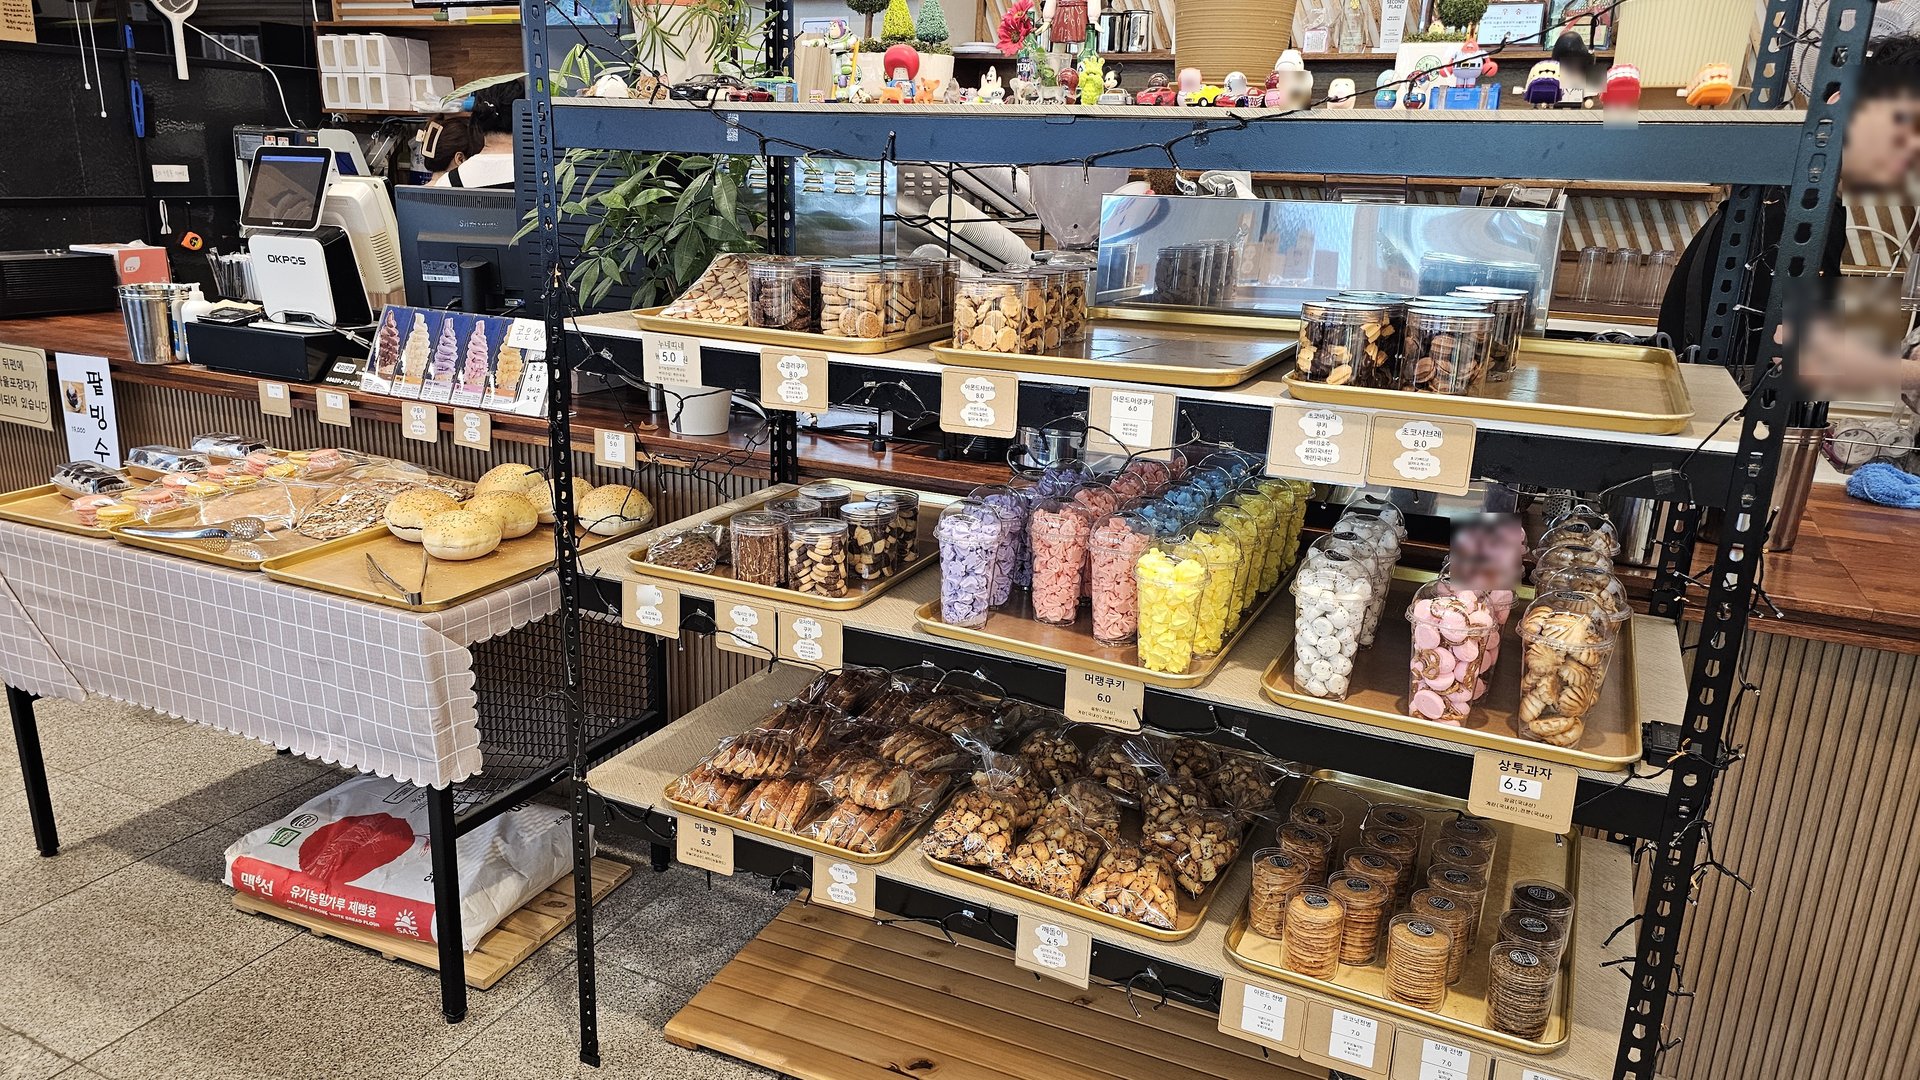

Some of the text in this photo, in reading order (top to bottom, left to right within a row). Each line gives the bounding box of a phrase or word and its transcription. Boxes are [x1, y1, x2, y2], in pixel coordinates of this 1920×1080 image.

[267, 254, 307, 266] OKPOS
[662, 351, 676, 362] 5.0
[20, 397, 48, 413] 있습니다
[86, 371, 111, 463] 팥빙수
[1401, 427, 1442, 438] 초코샤브레
[1413, 439, 1427, 448] 8.0
[1084, 673, 1125, 691] 머랭쿠키
[1097, 693, 1111, 703] 6.0
[1498, 759, 1553, 781] 상투과자
[1503, 777, 1528, 792] 6.5
[694, 822, 717, 836] 마늘빵
[701, 838, 712, 847] 5.5
[289, 885, 377, 918] 유기농밀가루 제빵용
[308, 906, 329, 916] STRONG
[345, 915, 363, 924] BREAD
[363, 918, 381, 927] FLOUR
[396, 926, 420, 938] SAJO
[1046, 937, 1059, 946] 4.5
[1253, 989, 1271, 999] 아몬드
[1449, 1048, 1463, 1057] 전병
[1441, 1058, 1452, 1067] 7.0
